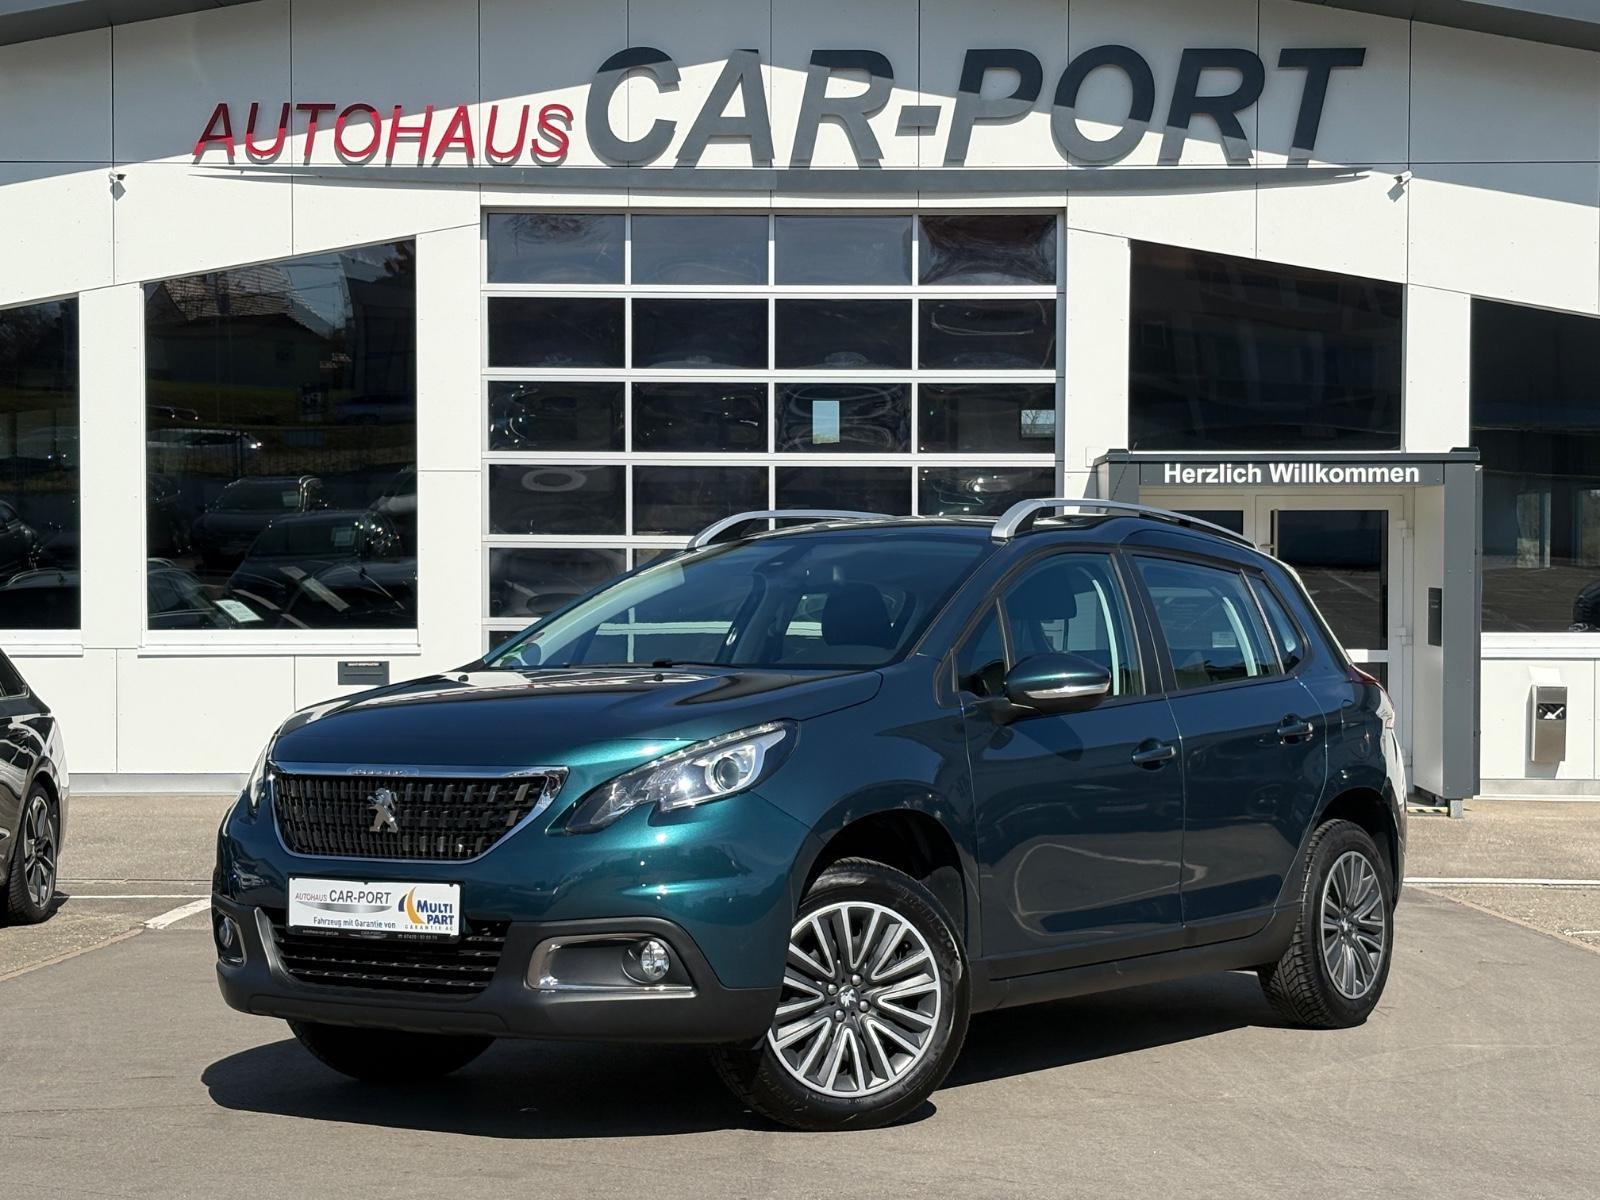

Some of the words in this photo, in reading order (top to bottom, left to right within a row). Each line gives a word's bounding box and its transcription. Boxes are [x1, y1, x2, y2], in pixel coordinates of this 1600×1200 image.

[192, 102, 574, 162] AUTOHAUS
[586, 45, 1366, 167] CAR-PORT
[1164, 462, 1262, 484] Herzlich
[1269, 462, 1420, 484] Willkommen
[295, 892, 328, 902] AUTOHAUS
[329, 889, 392, 905] CAR-PORT
[313, 916, 342, 928] Fahrzeug
[342, 918, 354, 928] mit
[354, 919, 383, 929] Garantie
[384, 921, 397, 929] von
[427, 914, 455, 926] PART
